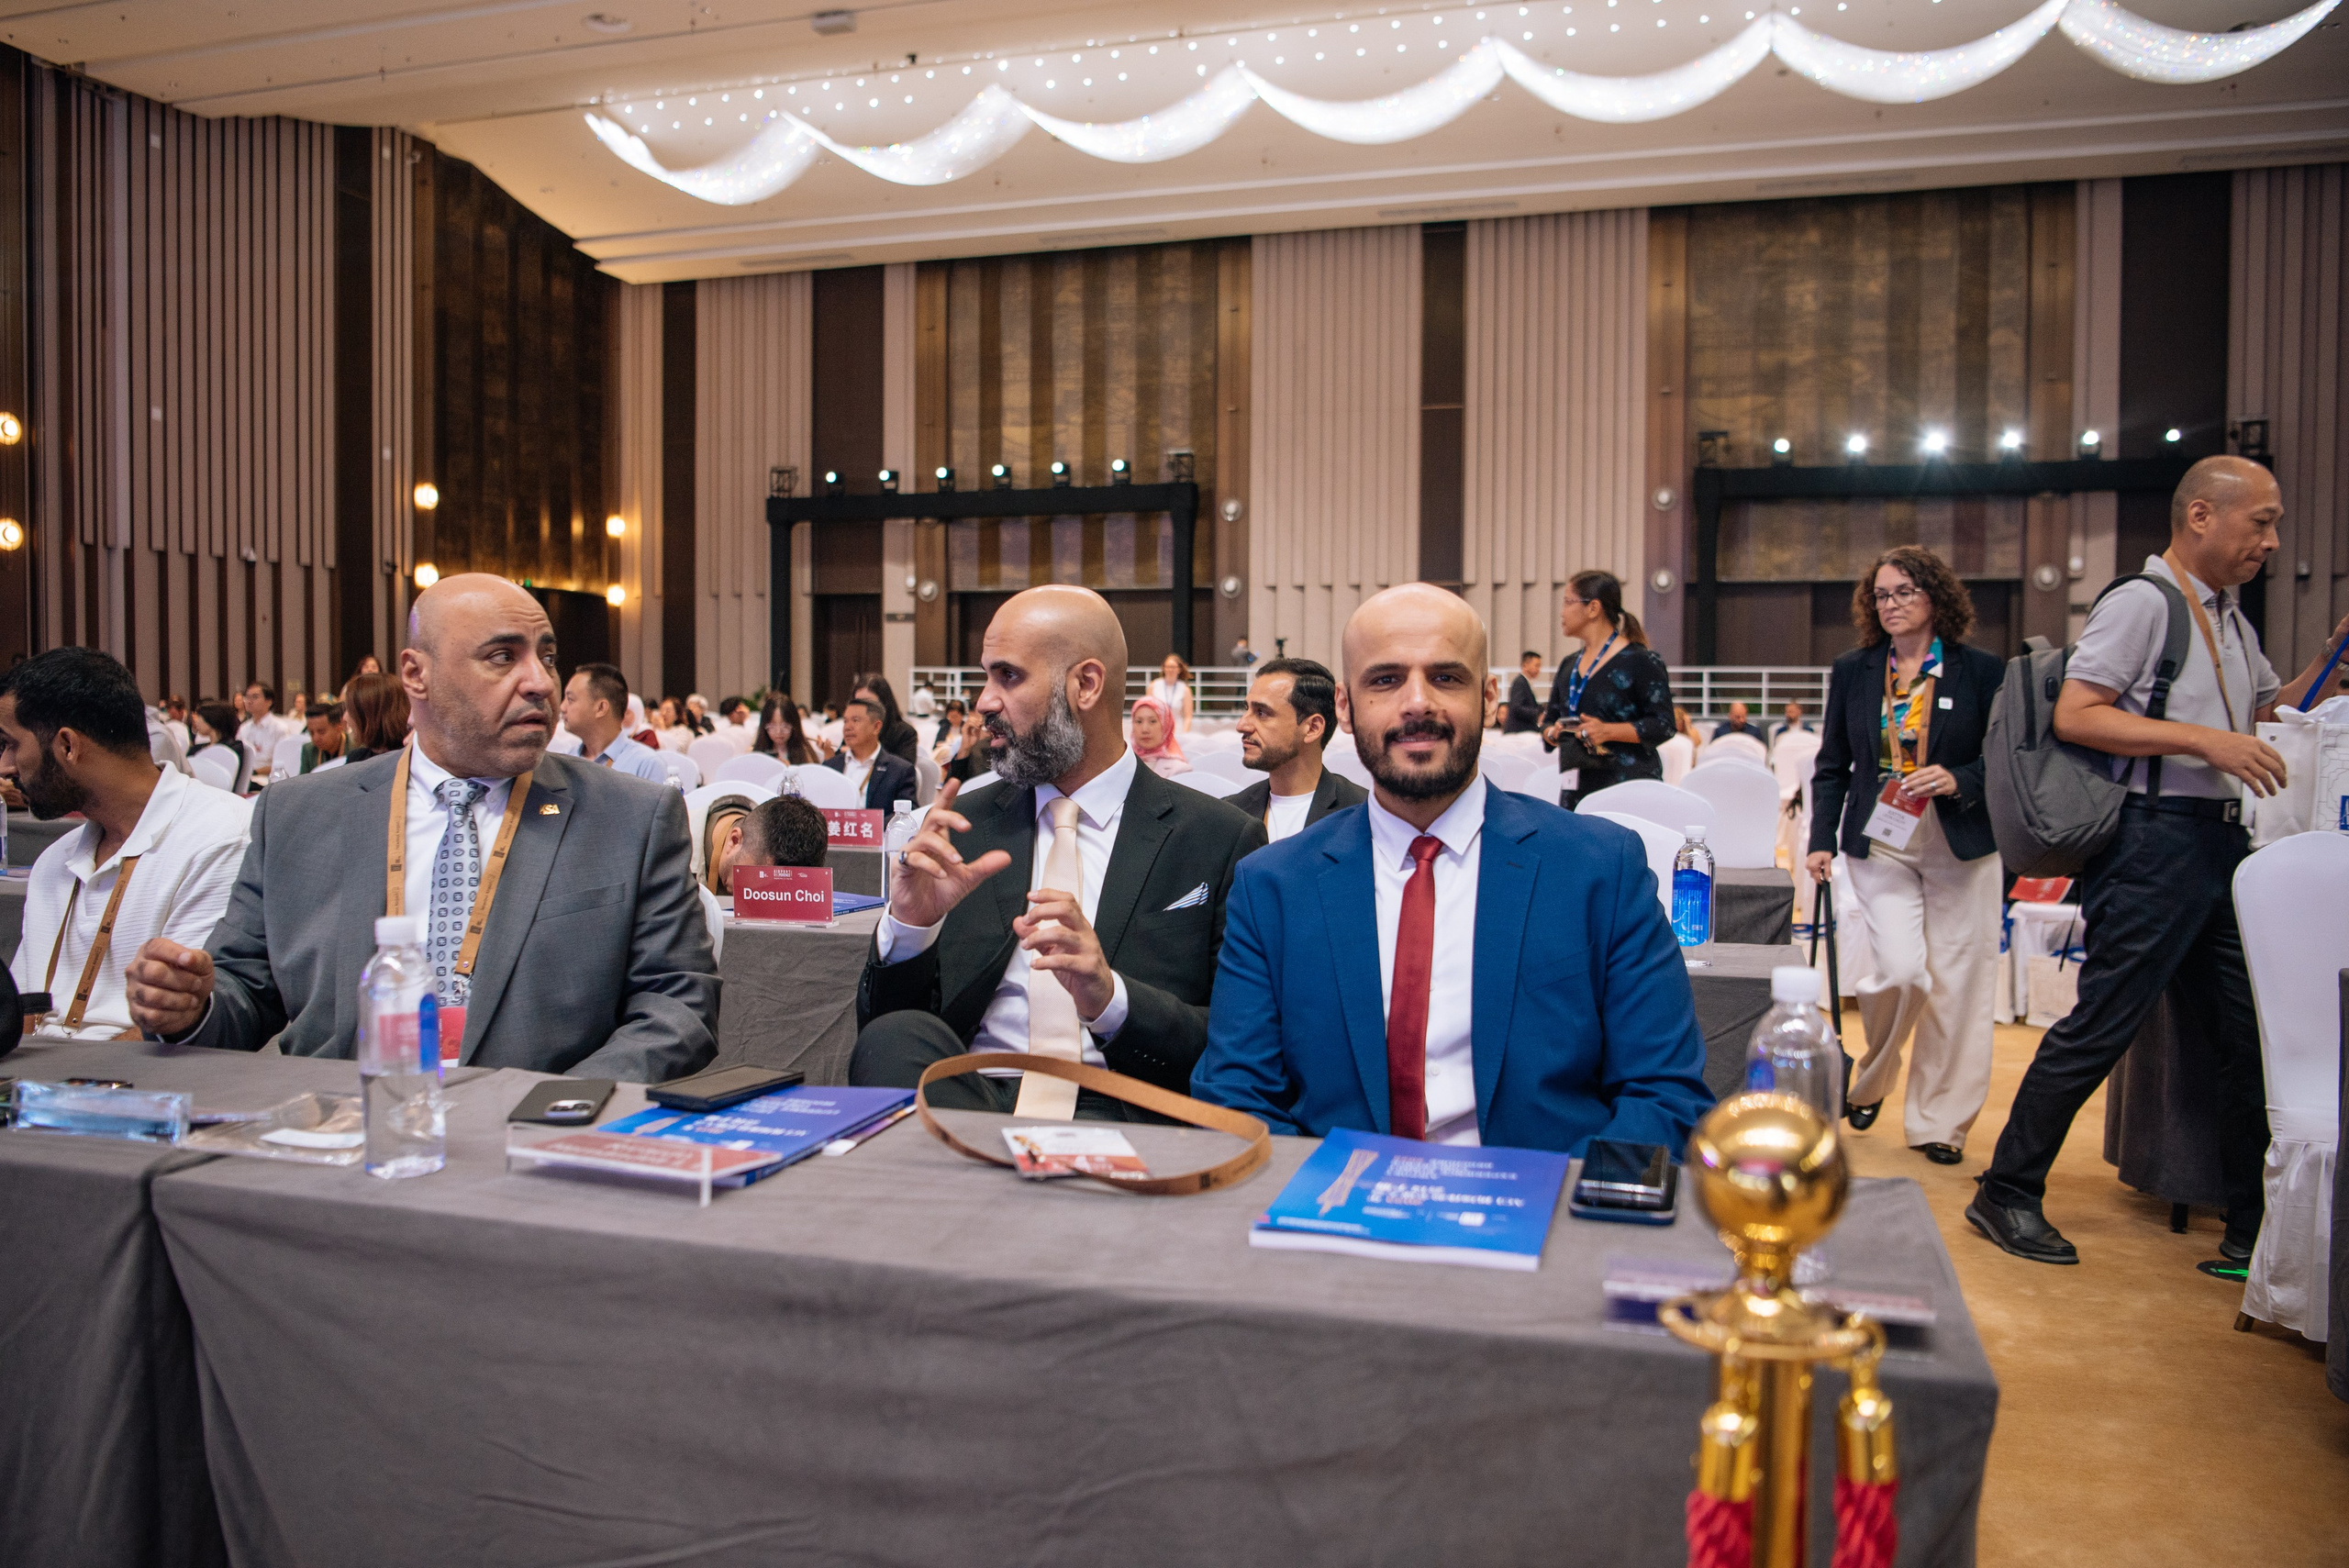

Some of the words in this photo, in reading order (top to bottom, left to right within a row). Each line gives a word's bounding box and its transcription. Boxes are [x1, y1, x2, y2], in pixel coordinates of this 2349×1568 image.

[828, 821, 873, 839] 姜红名
[743, 887, 791, 901] Doosun
[795, 889, 824, 902] Choi
